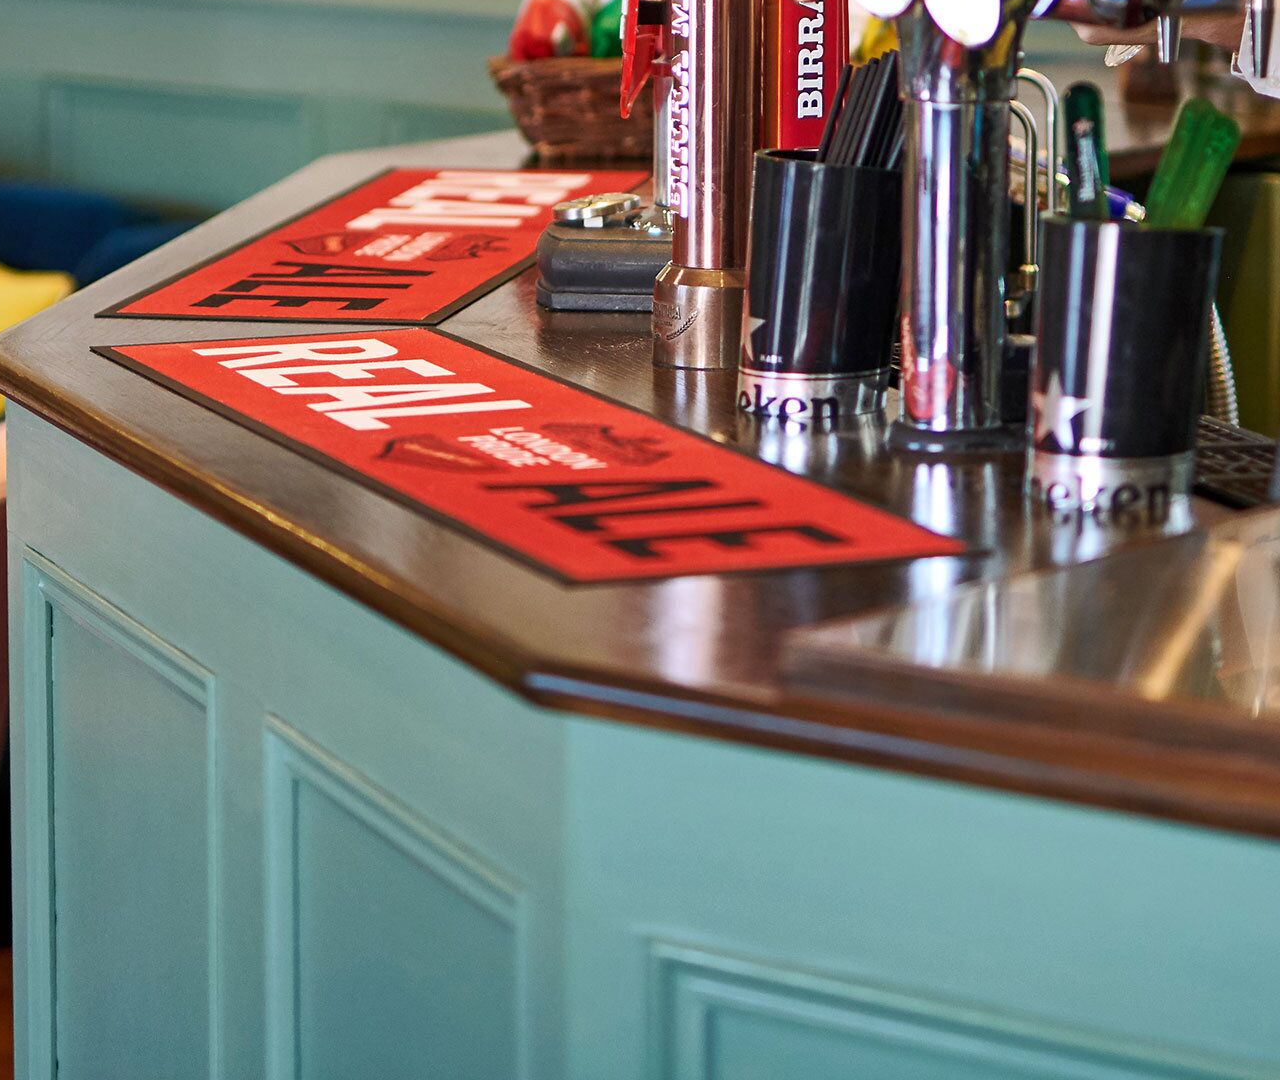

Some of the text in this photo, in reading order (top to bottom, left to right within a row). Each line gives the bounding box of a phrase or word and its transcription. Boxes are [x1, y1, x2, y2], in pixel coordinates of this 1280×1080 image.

[346, 170, 593, 231] REAL
[188, 260, 436, 311] ALE
[192, 338, 534, 432] REAL
[489, 425, 609, 471] LONDON
[480, 478, 850, 559] ALE
